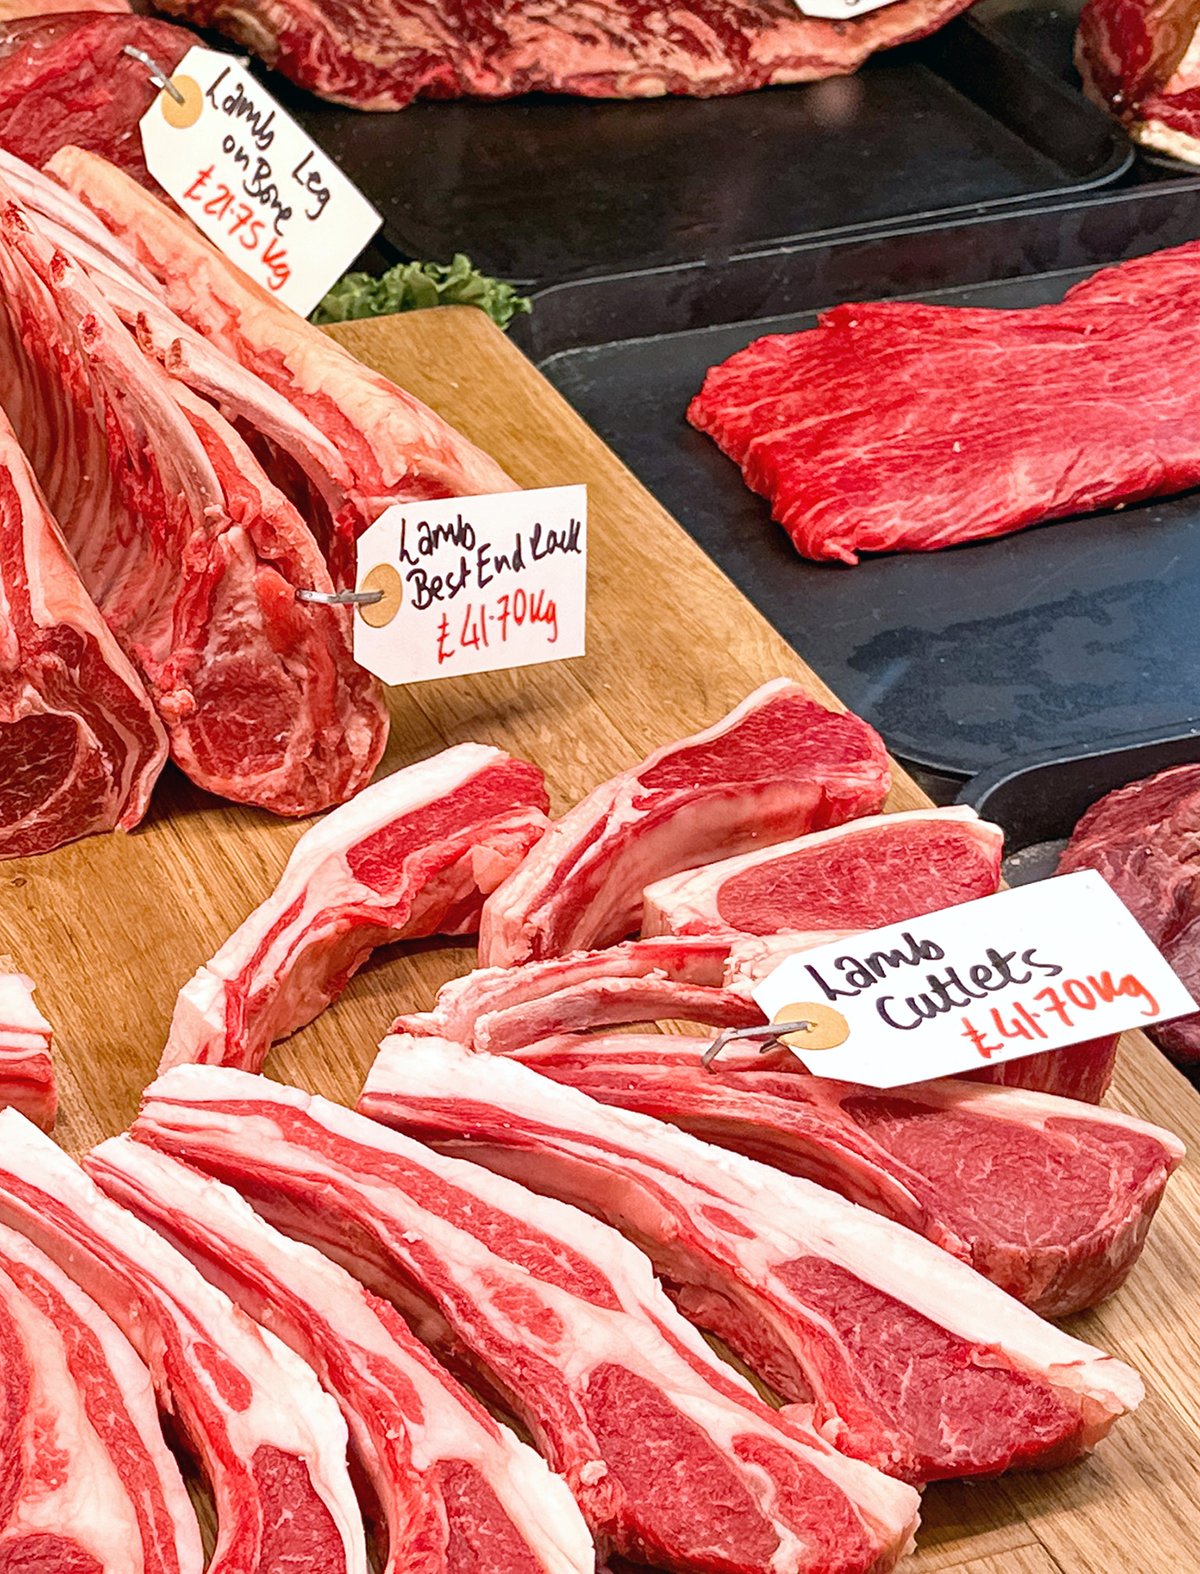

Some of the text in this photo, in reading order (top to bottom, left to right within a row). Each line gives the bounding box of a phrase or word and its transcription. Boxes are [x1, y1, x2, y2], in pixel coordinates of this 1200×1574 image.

[205, 66, 331, 221] Lamb Leg
[243, 156, 293, 237] Bone
[399, 514, 476, 566] Lamb
[405, 556, 472, 610] Best
[476, 533, 526, 589] End
[804, 932, 945, 1002] Lamb
[875, 948, 1064, 1031] Cutlets
